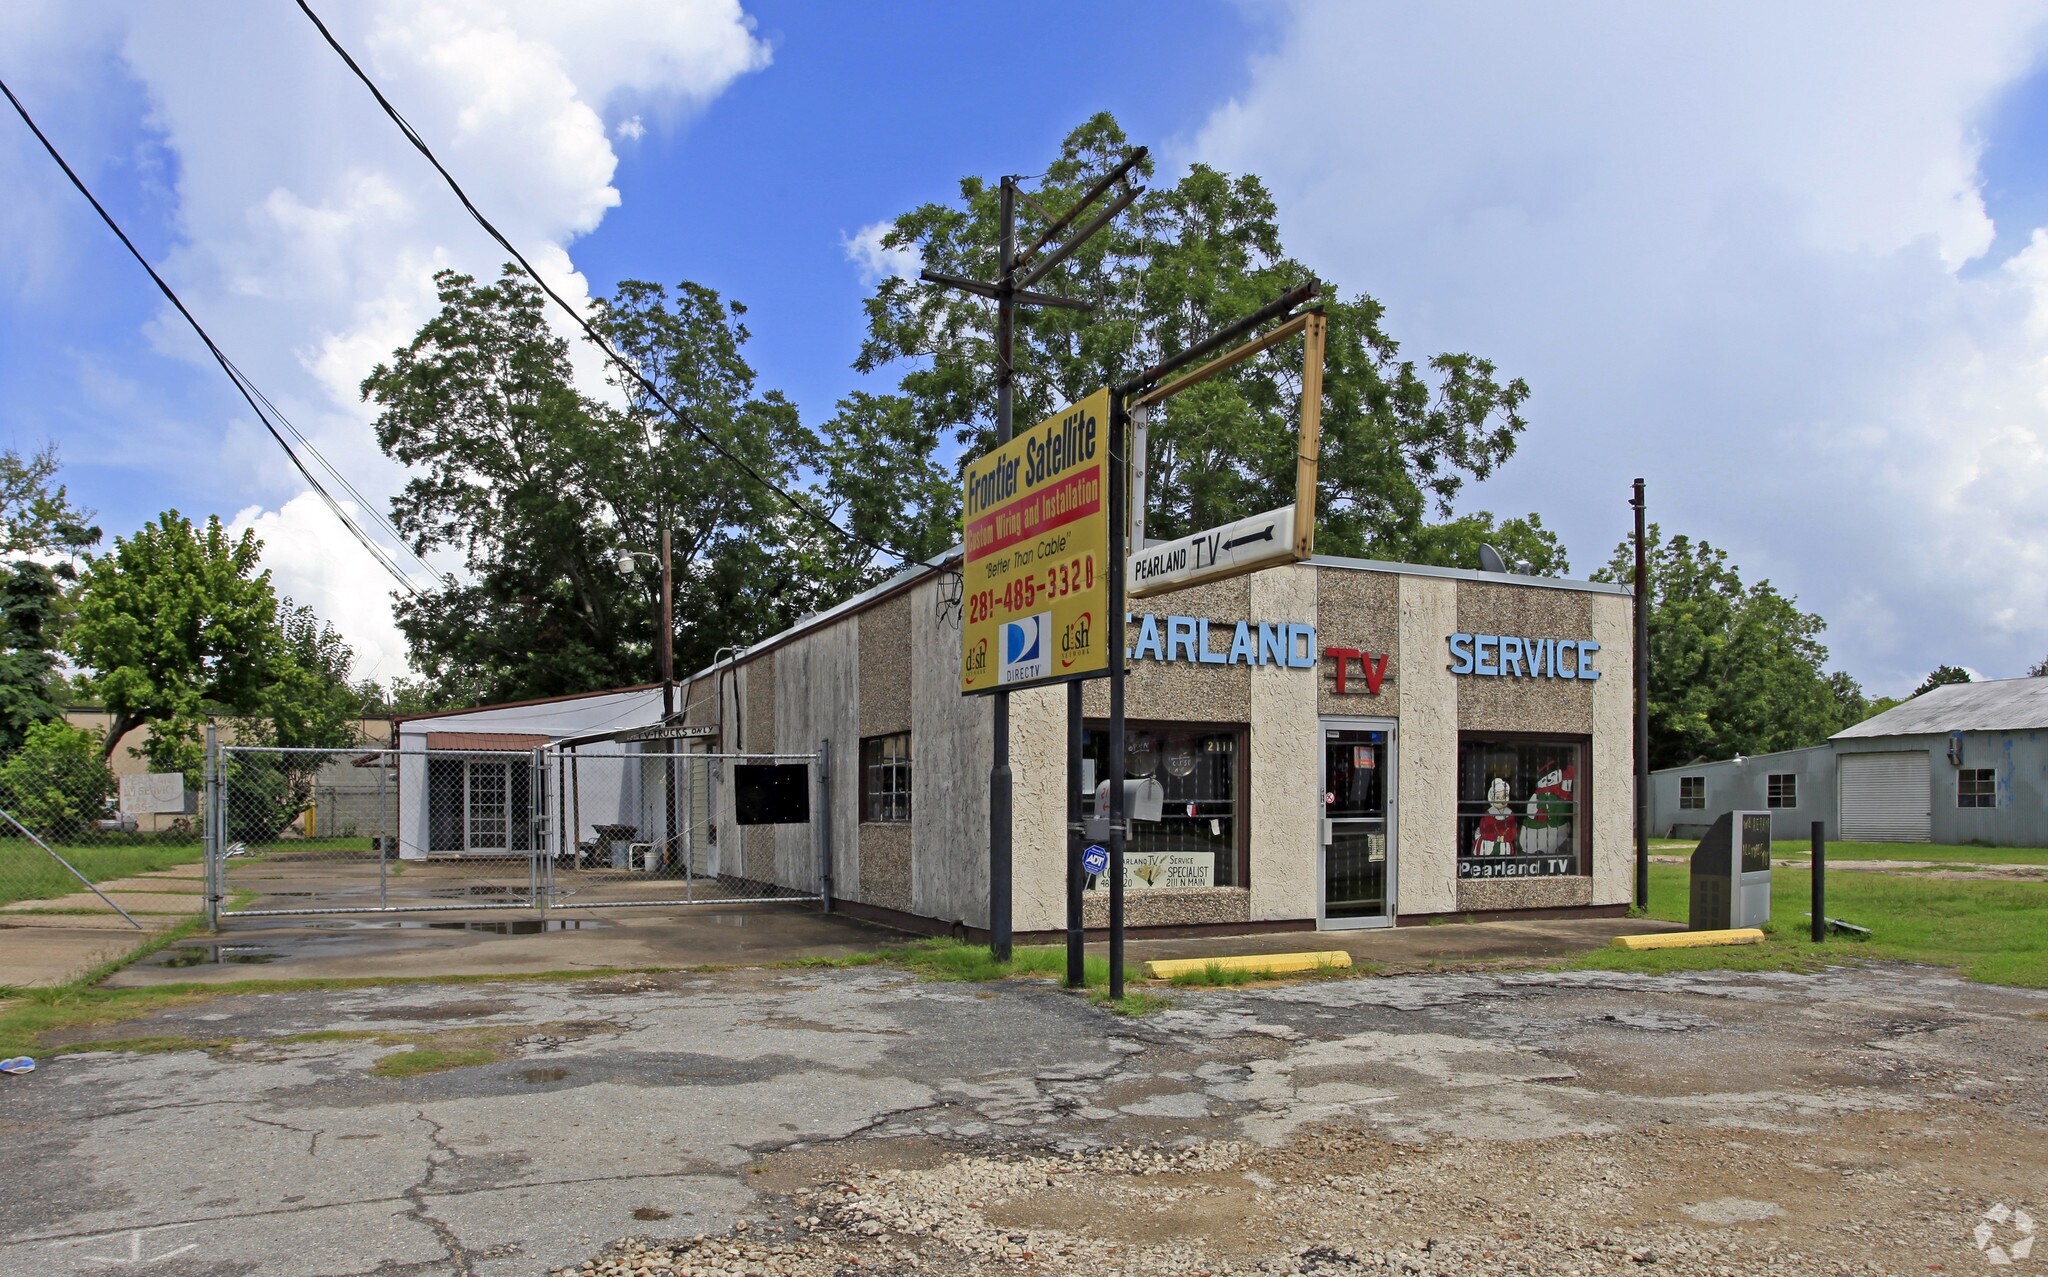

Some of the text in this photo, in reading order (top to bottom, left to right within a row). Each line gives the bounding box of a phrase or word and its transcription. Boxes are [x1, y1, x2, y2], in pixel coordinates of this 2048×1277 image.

[969, 410, 1096, 516] Frontier Satellite
[968, 478, 1098, 551] Custom Wiring and Installation
[1014, 549, 1034, 569] Than
[1135, 532, 1221, 581] PEARLAND TV
[970, 554, 1094, 624] 281-485-3320
[1062, 621, 1090, 652] dish
[966, 645, 986, 672] dish
[1126, 612, 1389, 695] ARLAND TV
[1449, 632, 1601, 680] SERVICE
[1007, 664, 1041, 682] DIRECTV
[691, 726, 713, 735] ONLY
[1207, 741, 1233, 752] 2111
[1086, 853, 1105, 867] ADT
[1147, 855, 1159, 867] TV
[1459, 858, 1568, 877] Pearland TV
[1167, 866, 1209, 878] SPECIALIST
[1180, 879, 1186, 887] N
[1187, 878, 1206, 887] MAIN
